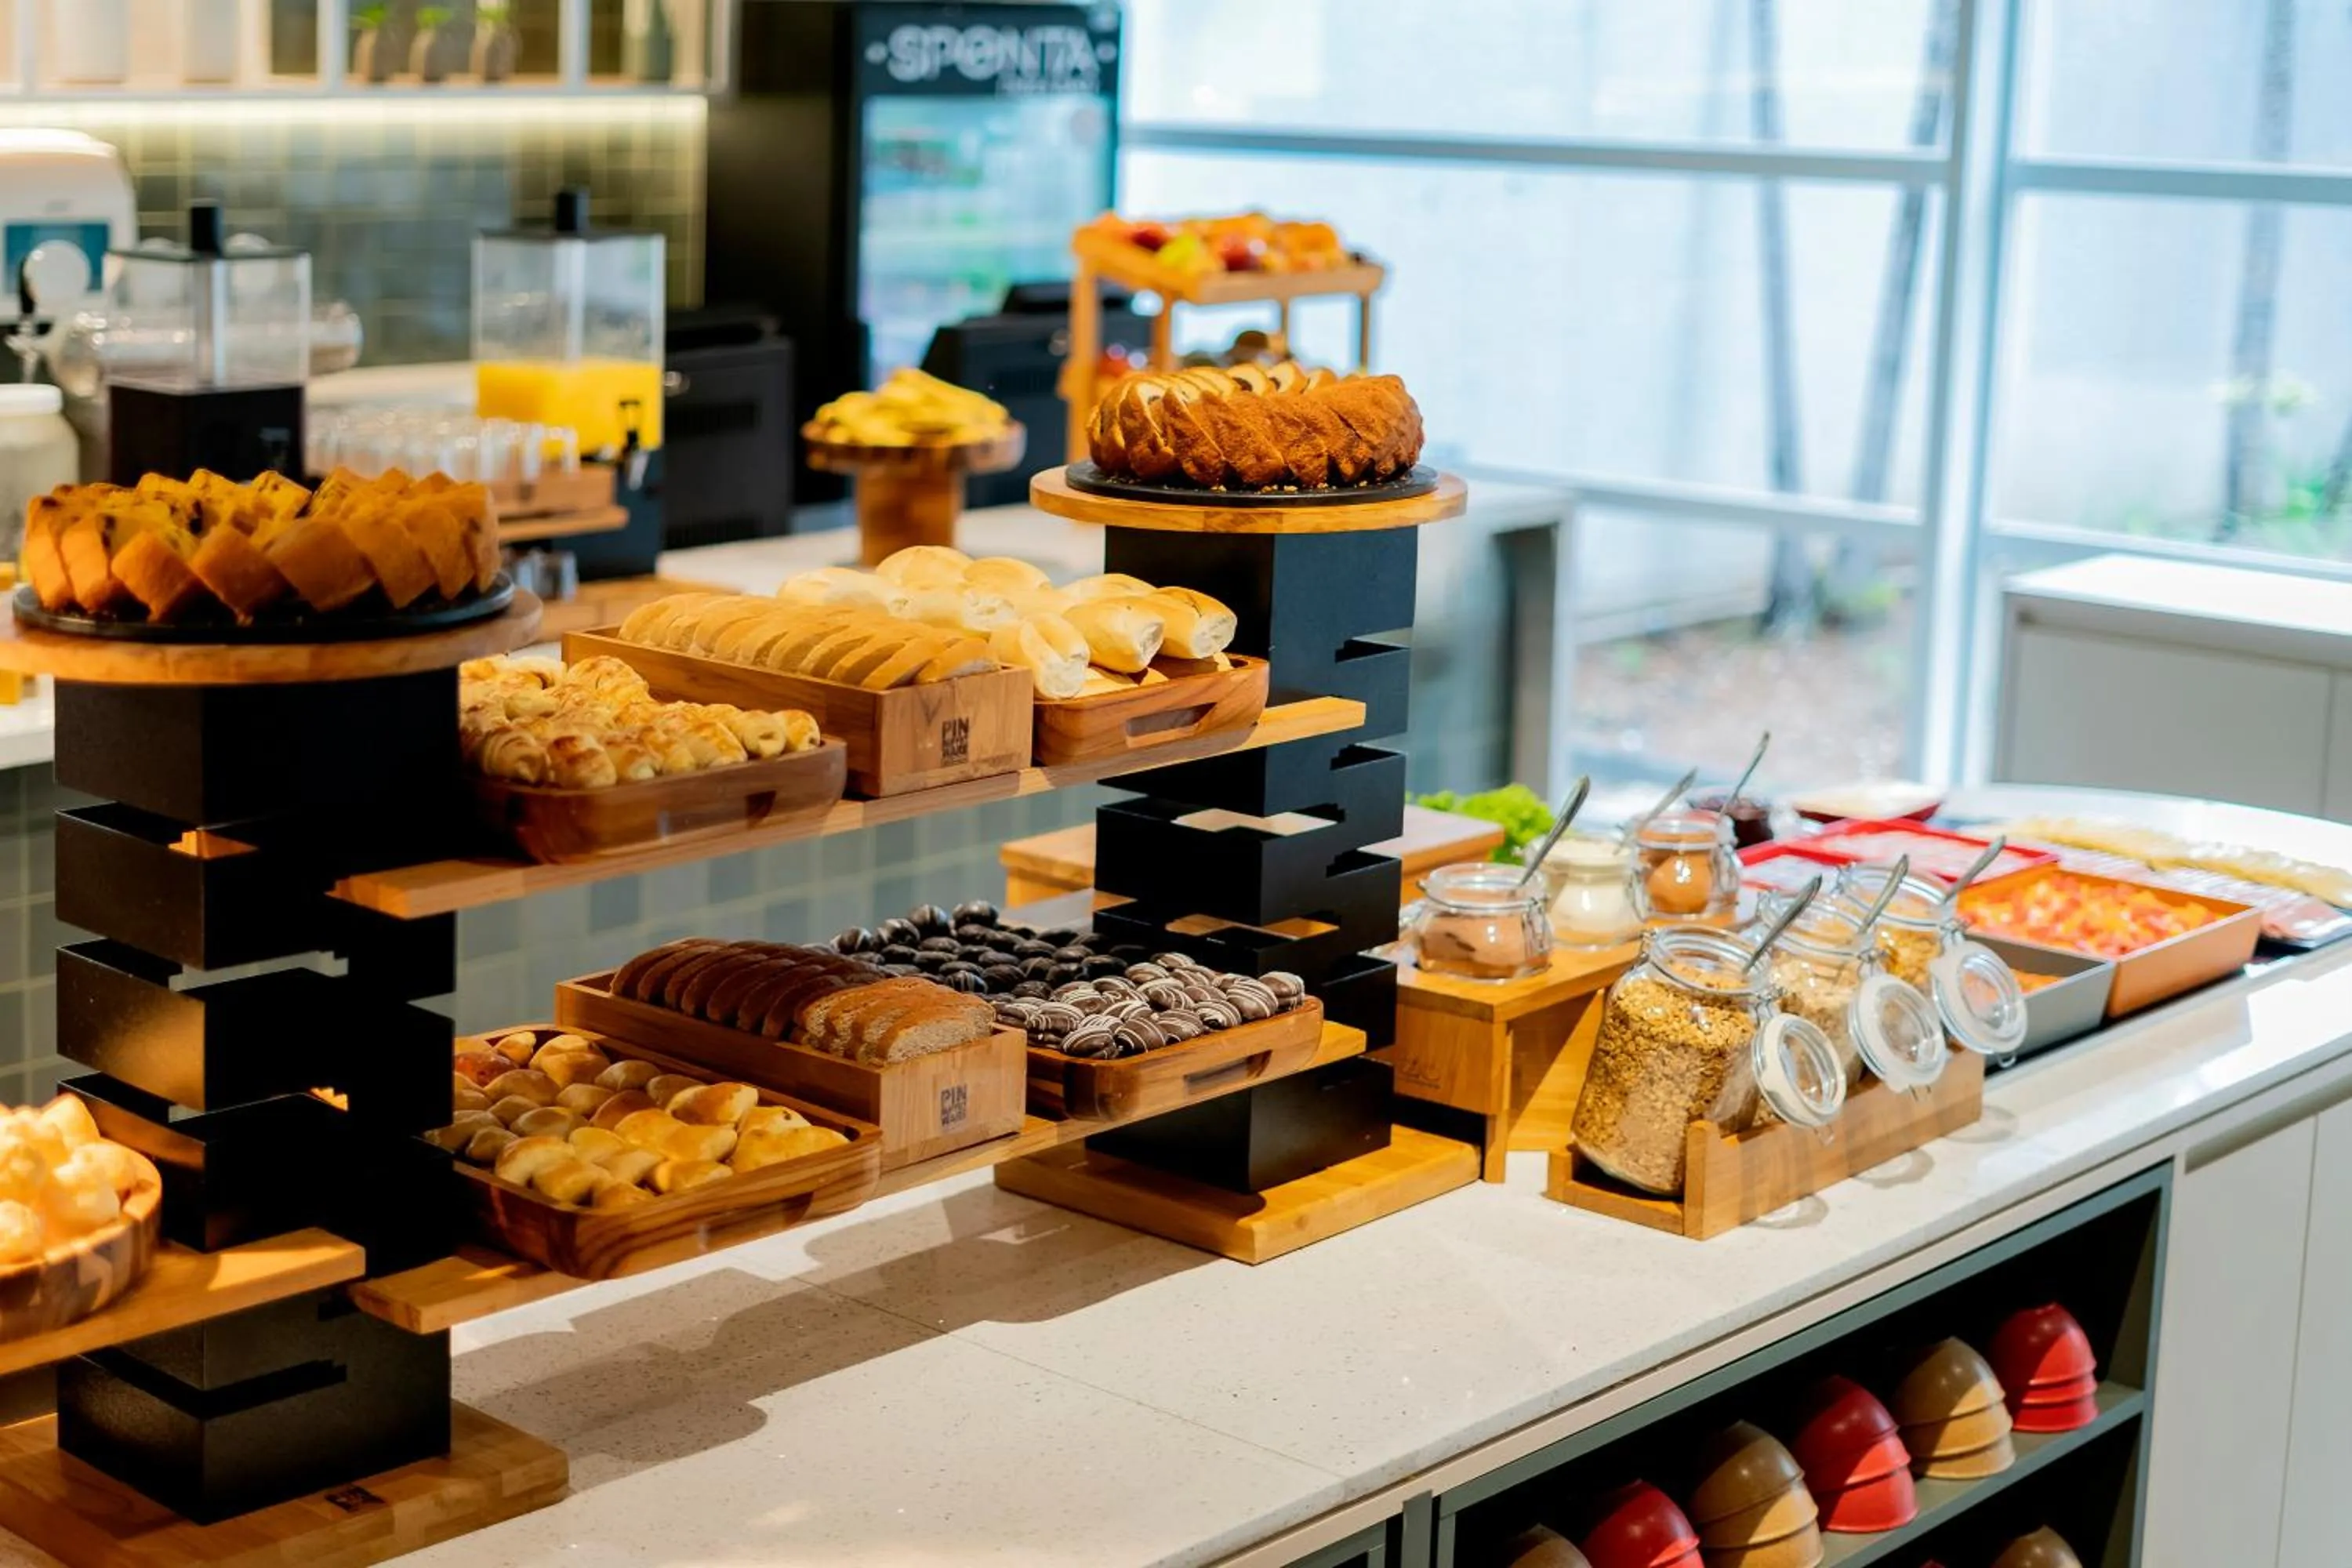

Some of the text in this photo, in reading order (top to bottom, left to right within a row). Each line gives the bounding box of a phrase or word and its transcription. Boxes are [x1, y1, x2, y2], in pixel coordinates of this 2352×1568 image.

[887, 24, 1099, 81] SPONTA
[942, 717, 969, 739] PIN
[941, 1084, 967, 1108] PIN
